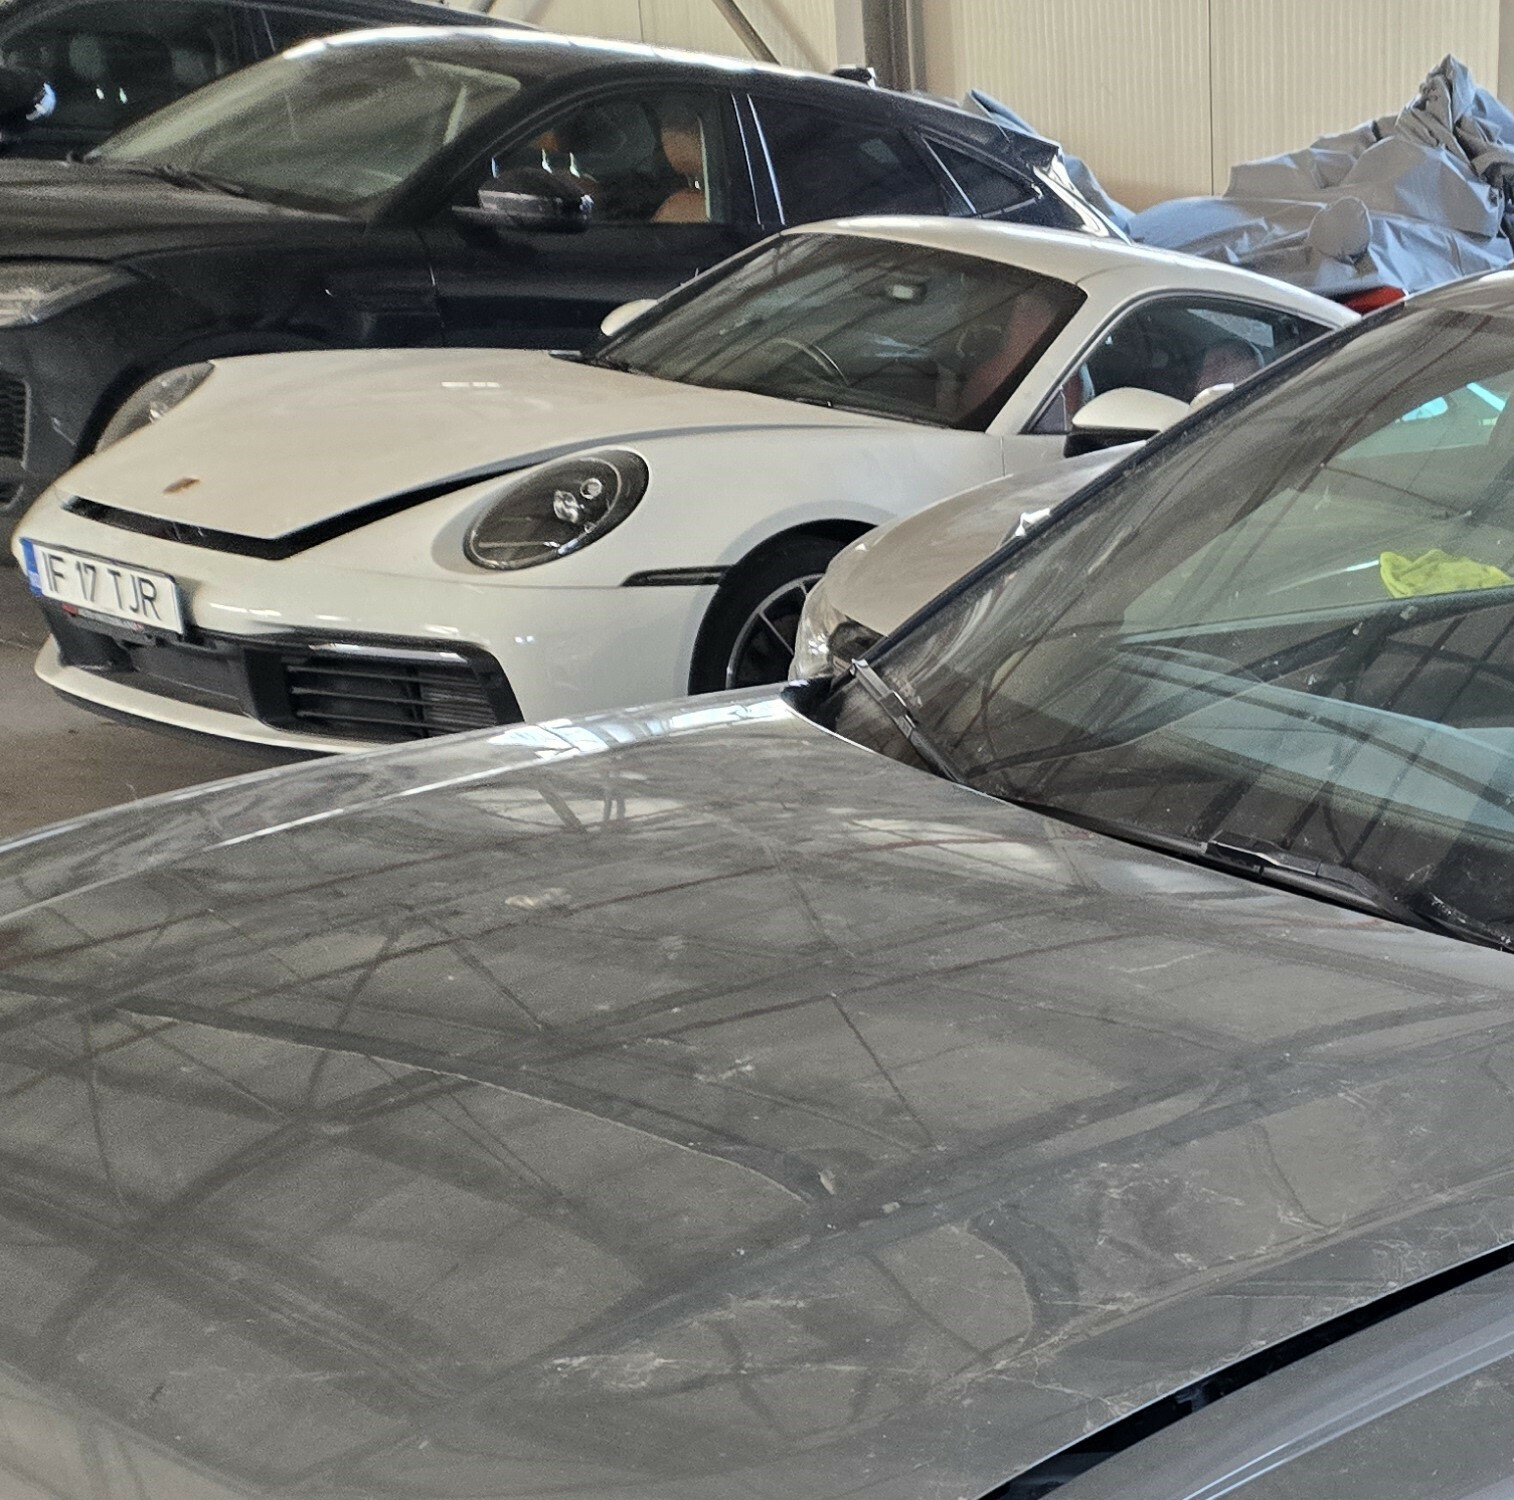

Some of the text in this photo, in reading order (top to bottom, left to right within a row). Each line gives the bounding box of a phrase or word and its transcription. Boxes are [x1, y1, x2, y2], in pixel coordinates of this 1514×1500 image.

[42, 551, 65, 594] IF
[75, 561, 96, 602] 17
[107, 569, 162, 620] TJR
